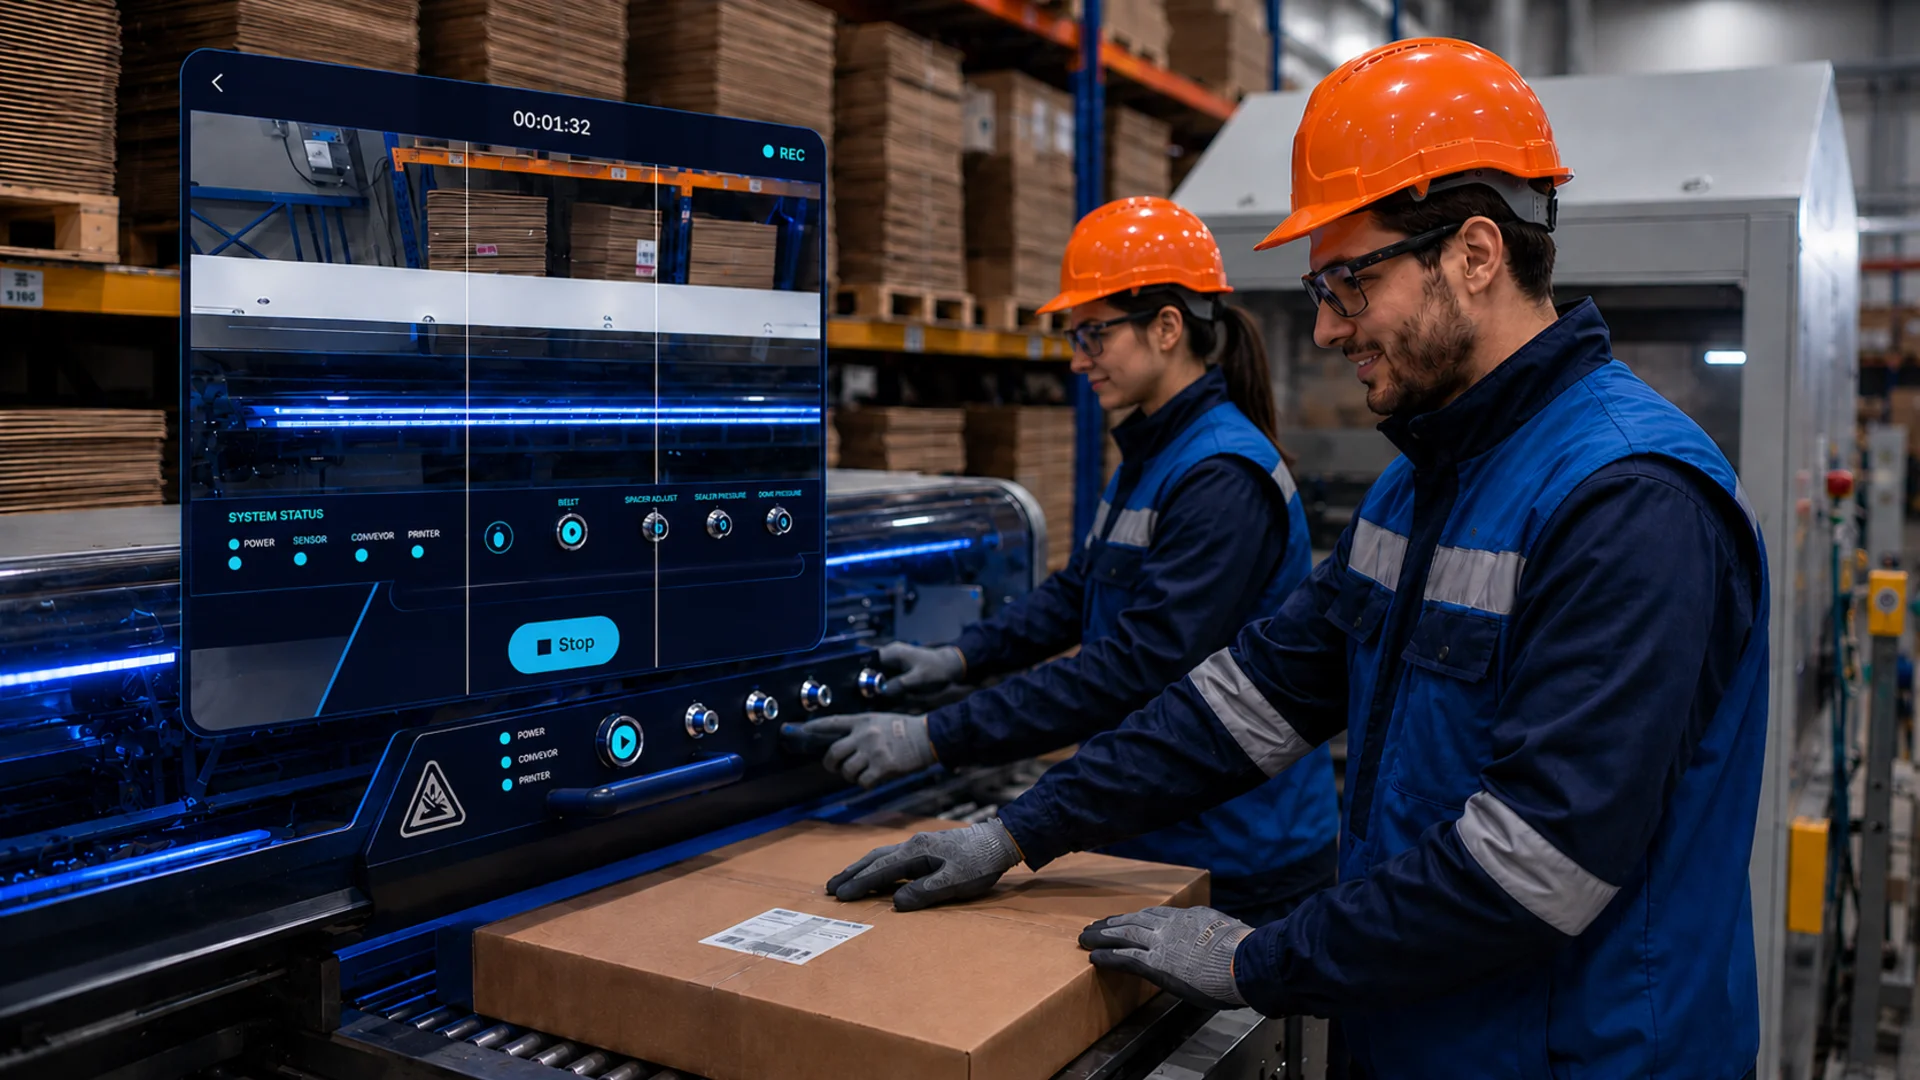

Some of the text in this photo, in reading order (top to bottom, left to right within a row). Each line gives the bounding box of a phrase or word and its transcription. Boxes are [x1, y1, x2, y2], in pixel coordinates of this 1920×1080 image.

[512, 110, 591, 136] 00:01:32
[779, 146, 805, 162] REC
[228, 508, 324, 523] SYSTEM STATUS
[292, 535, 328, 545] SENSOR
[351, 531, 395, 542] CONVEYOR
[407, 529, 440, 539] PRINTER
[243, 538, 275, 548] POWER
[559, 637, 595, 653] Stop
[517, 727, 545, 740] POWER
[518, 770, 551, 785] PRINTER
